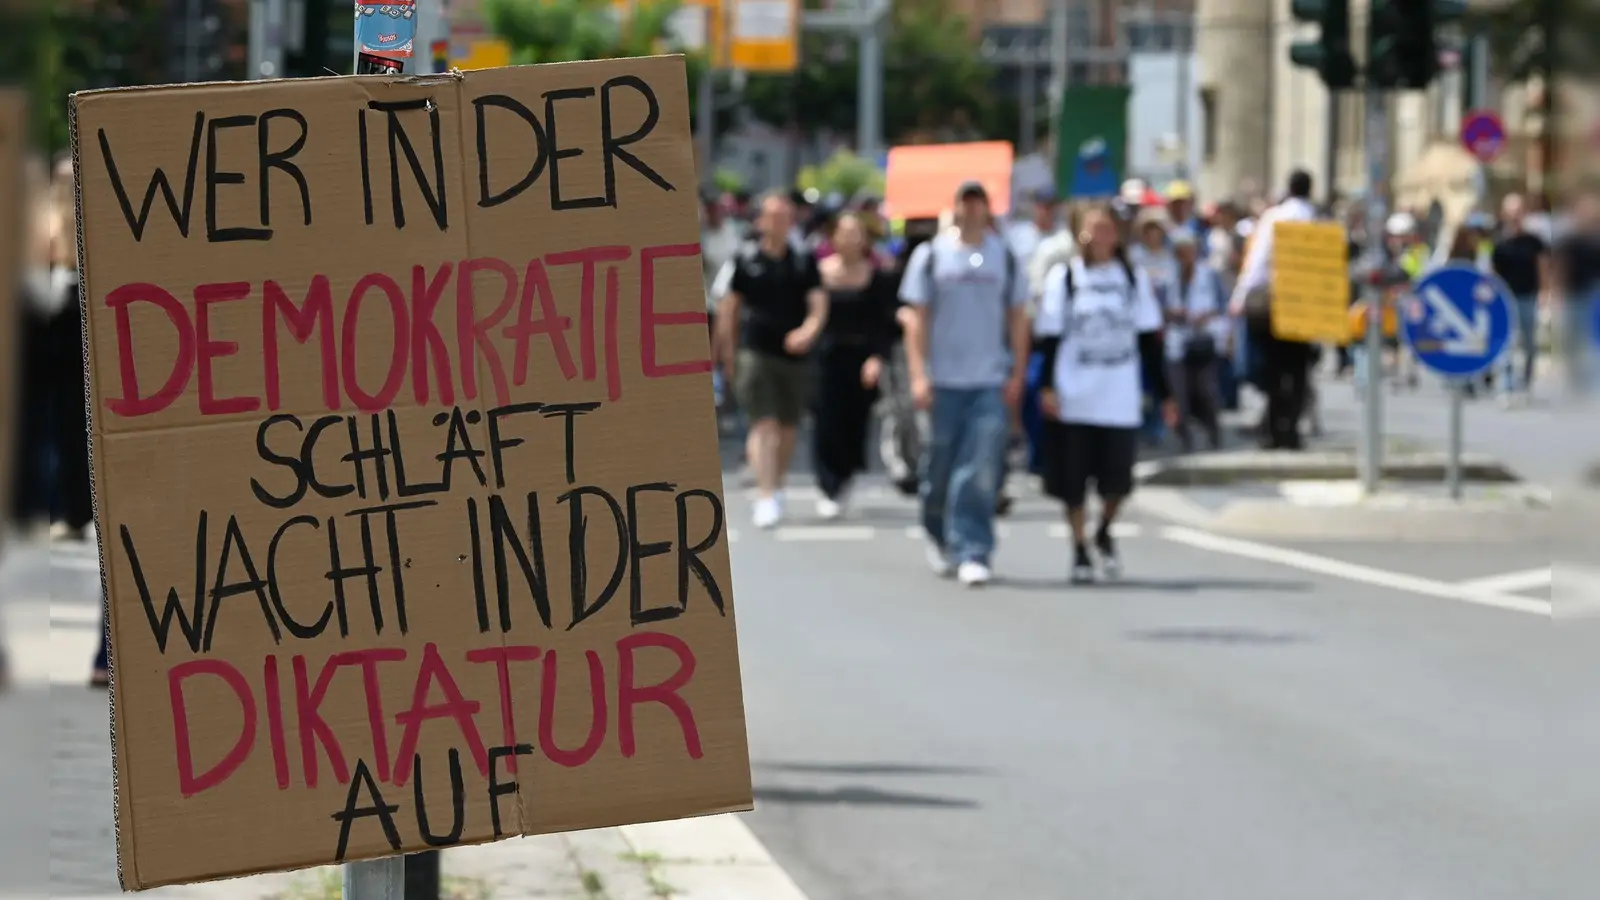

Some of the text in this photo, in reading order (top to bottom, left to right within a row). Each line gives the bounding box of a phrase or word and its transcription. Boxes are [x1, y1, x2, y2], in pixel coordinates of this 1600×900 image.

[98, 76, 676, 241] WER IN DER
[106, 243, 711, 415] DEMOKRATIE
[250, 401, 601, 508] SCHLÄFT
[120, 482, 726, 653] WACHT IN DER
[168, 632, 702, 797] DIKTATUR
[332, 744, 534, 863] AUF
